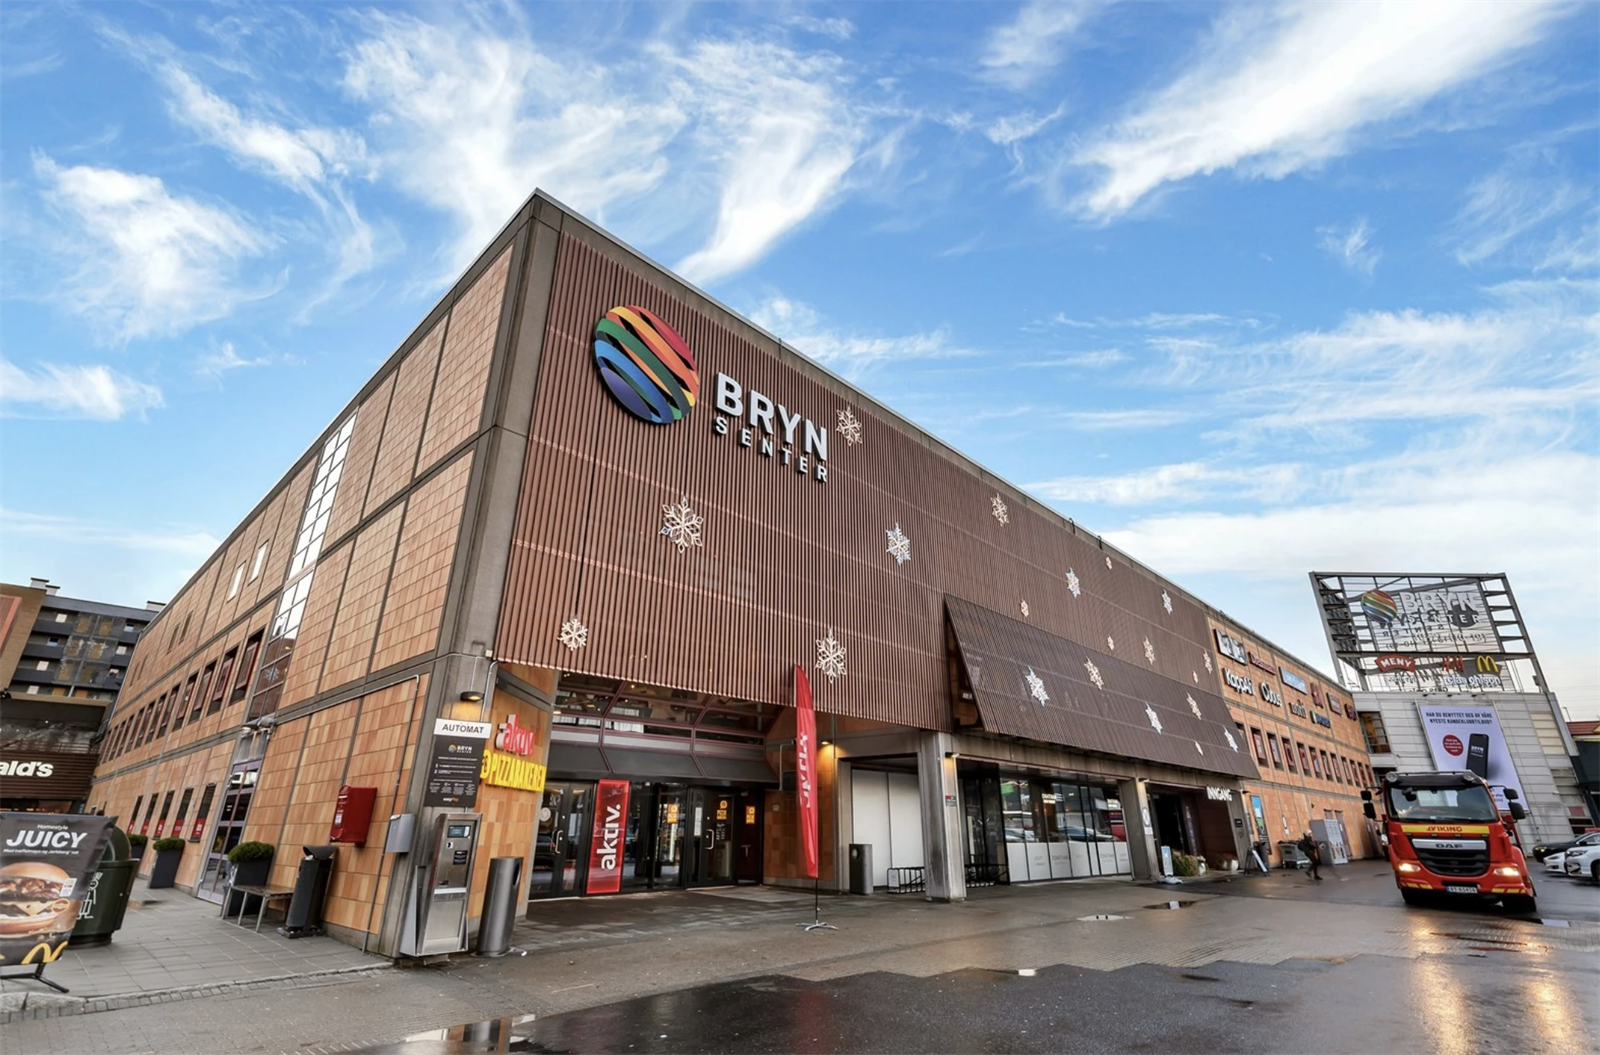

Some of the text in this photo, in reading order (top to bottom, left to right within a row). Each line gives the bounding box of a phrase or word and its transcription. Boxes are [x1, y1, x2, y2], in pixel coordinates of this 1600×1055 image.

[715, 371, 828, 462] BRYN
[714, 415, 828, 484] SENTER
[1400, 591, 1480, 613] BRYN
[1380, 657, 1412, 668] MENY
[442, 724, 484, 734] AUTOMAT
[6, 829, 88, 849] JUICY
[596, 803, 621, 870] aktiv.
